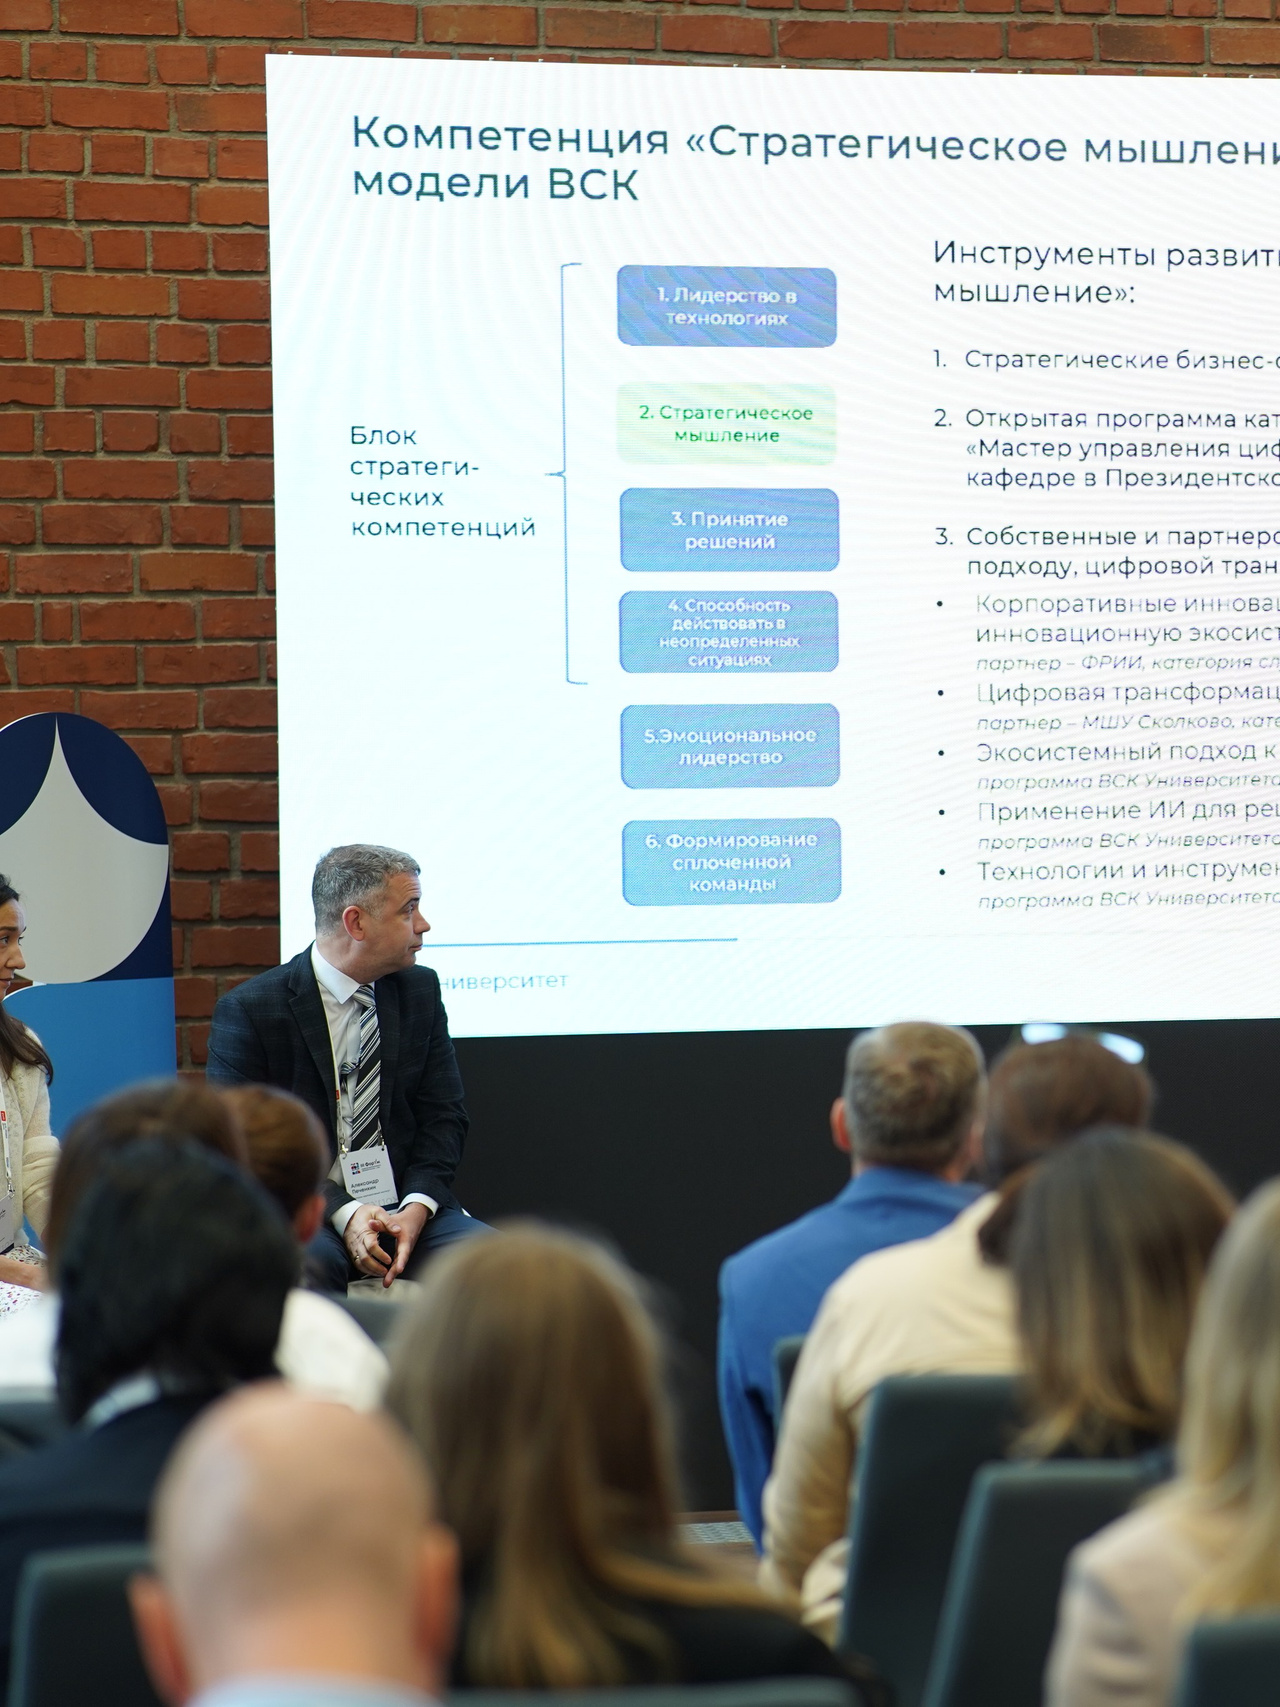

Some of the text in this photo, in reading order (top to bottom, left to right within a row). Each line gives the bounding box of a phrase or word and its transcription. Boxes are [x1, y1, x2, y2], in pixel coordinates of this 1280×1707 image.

[353, 114, 668, 160] Компетенция
[686, 123, 1067, 170] «Стратегическое
[354, 167, 638, 204] модели ВСК
[934, 239, 1155, 272] Инструменты
[657, 286, 798, 307] 1. Лидерство в
[935, 283, 1135, 305] мышление»:
[667, 312, 788, 326] технологиях
[933, 348, 947, 368] 1.
[964, 348, 1169, 373] Стратегические
[639, 404, 814, 423] 2. Стратегическое
[934, 408, 952, 428] 2.
[965, 408, 1087, 432] Открытая
[1096, 412, 1237, 432] программа
[350, 425, 417, 446] Блок
[674, 430, 781, 444] мышление
[966, 438, 1072, 458] «Мастер
[1078, 441, 1230, 462] управления
[349, 460, 479, 480] стратеги-
[967, 467, 1076, 492] кафедре
[1084, 471, 1097, 487] в
[350, 491, 444, 507] ческих
[352, 517, 535, 540] компетенций
[671, 510, 789, 528] 3. Принятие
[685, 534, 776, 552] решений
[935, 527, 954, 546] 3.
[966, 525, 1137, 546] Собственные
[1145, 531, 1159, 546] и
[968, 559, 1078, 580] подходу,
[1085, 555, 1214, 579] цифровой
[668, 597, 791, 613] 4. Способность
[977, 594, 1177, 618] Корпоративные
[672, 615, 787, 632] действовать в
[659, 636, 801, 650] неопределенных
[976, 626, 1183, 648] инновационную
[688, 654, 772, 670] ситуациях
[976, 658, 1062, 674] партнер
[1081, 654, 1146, 671] ФРИИ,
[1151, 656, 1254, 673] категория
[978, 682, 1106, 707] Цифровая
[977, 717, 1063, 735] партнер
[1082, 714, 1134, 731] МШУ
[1137, 712, 1236, 730] Сколково,
[644, 728, 817, 746] 5.Эмоциональное
[679, 752, 783, 768] лидерство
[977, 741, 1162, 763] Экосистемный
[1169, 743, 1257, 763] подход
[1264, 744, 1276, 759] к
[977, 777, 1093, 793] программа
[1097, 772, 1140, 789] ВСК
[979, 800, 1142, 826] Применение
[1149, 800, 1185, 819] ИИ
[1191, 802, 1237, 822] для
[645, 833, 818, 851] 6. Формирование
[978, 836, 1094, 853] программа
[1098, 832, 1140, 849] ВСК
[672, 853, 792, 871] сплоченной
[977, 859, 1124, 882] Технологии
[1132, 863, 1146, 879] и
[689, 878, 777, 894] команды
[978, 895, 1094, 912] программа
[1099, 890, 1141, 907] ВСК
[439, 974, 569, 993] ниверситет
